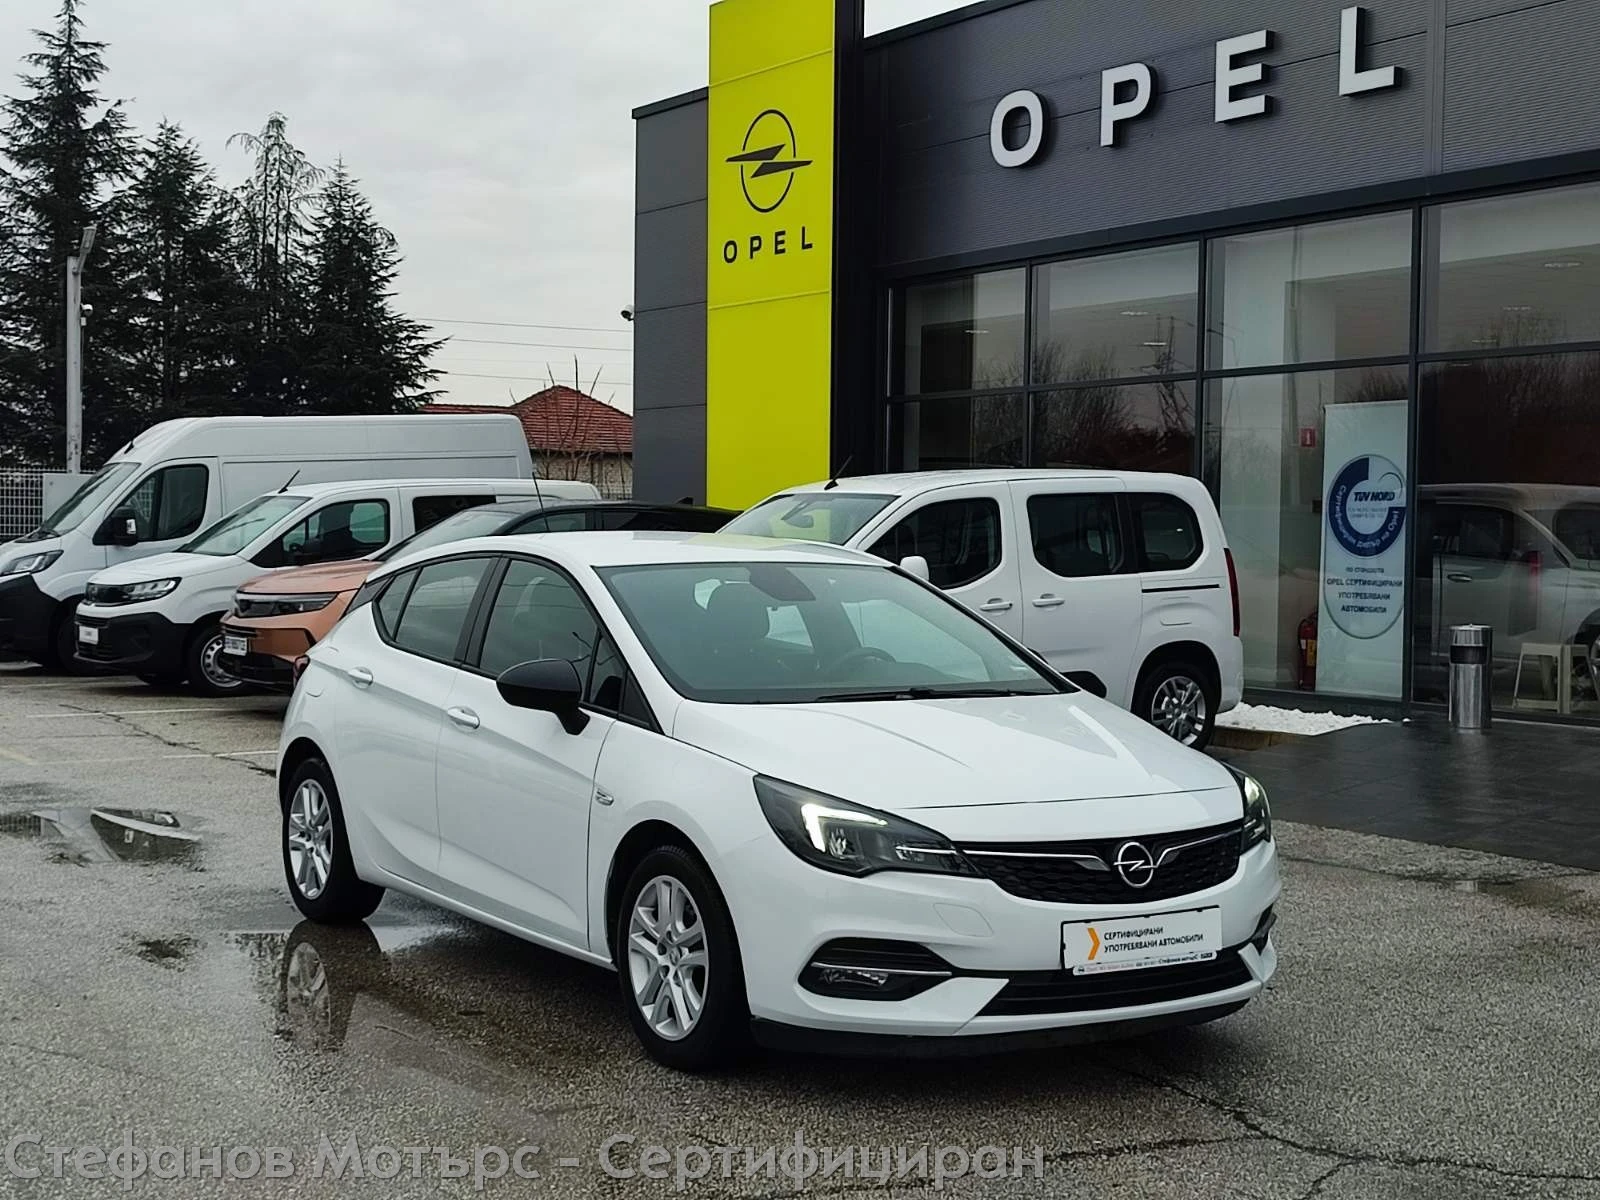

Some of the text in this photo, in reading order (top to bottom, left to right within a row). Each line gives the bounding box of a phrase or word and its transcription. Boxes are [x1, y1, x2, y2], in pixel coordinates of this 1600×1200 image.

[989, 6, 1398, 168] OPEL
[723, 226, 813, 264] OPEL
[1371, 491, 1396, 502] NORD
[1103, 927, 1164, 941] СЕРТИФИЦИРАНИ
[1103, 934, 1204, 953] УПОТРЕБЯВАНИ АВТОМОБИЛИ
